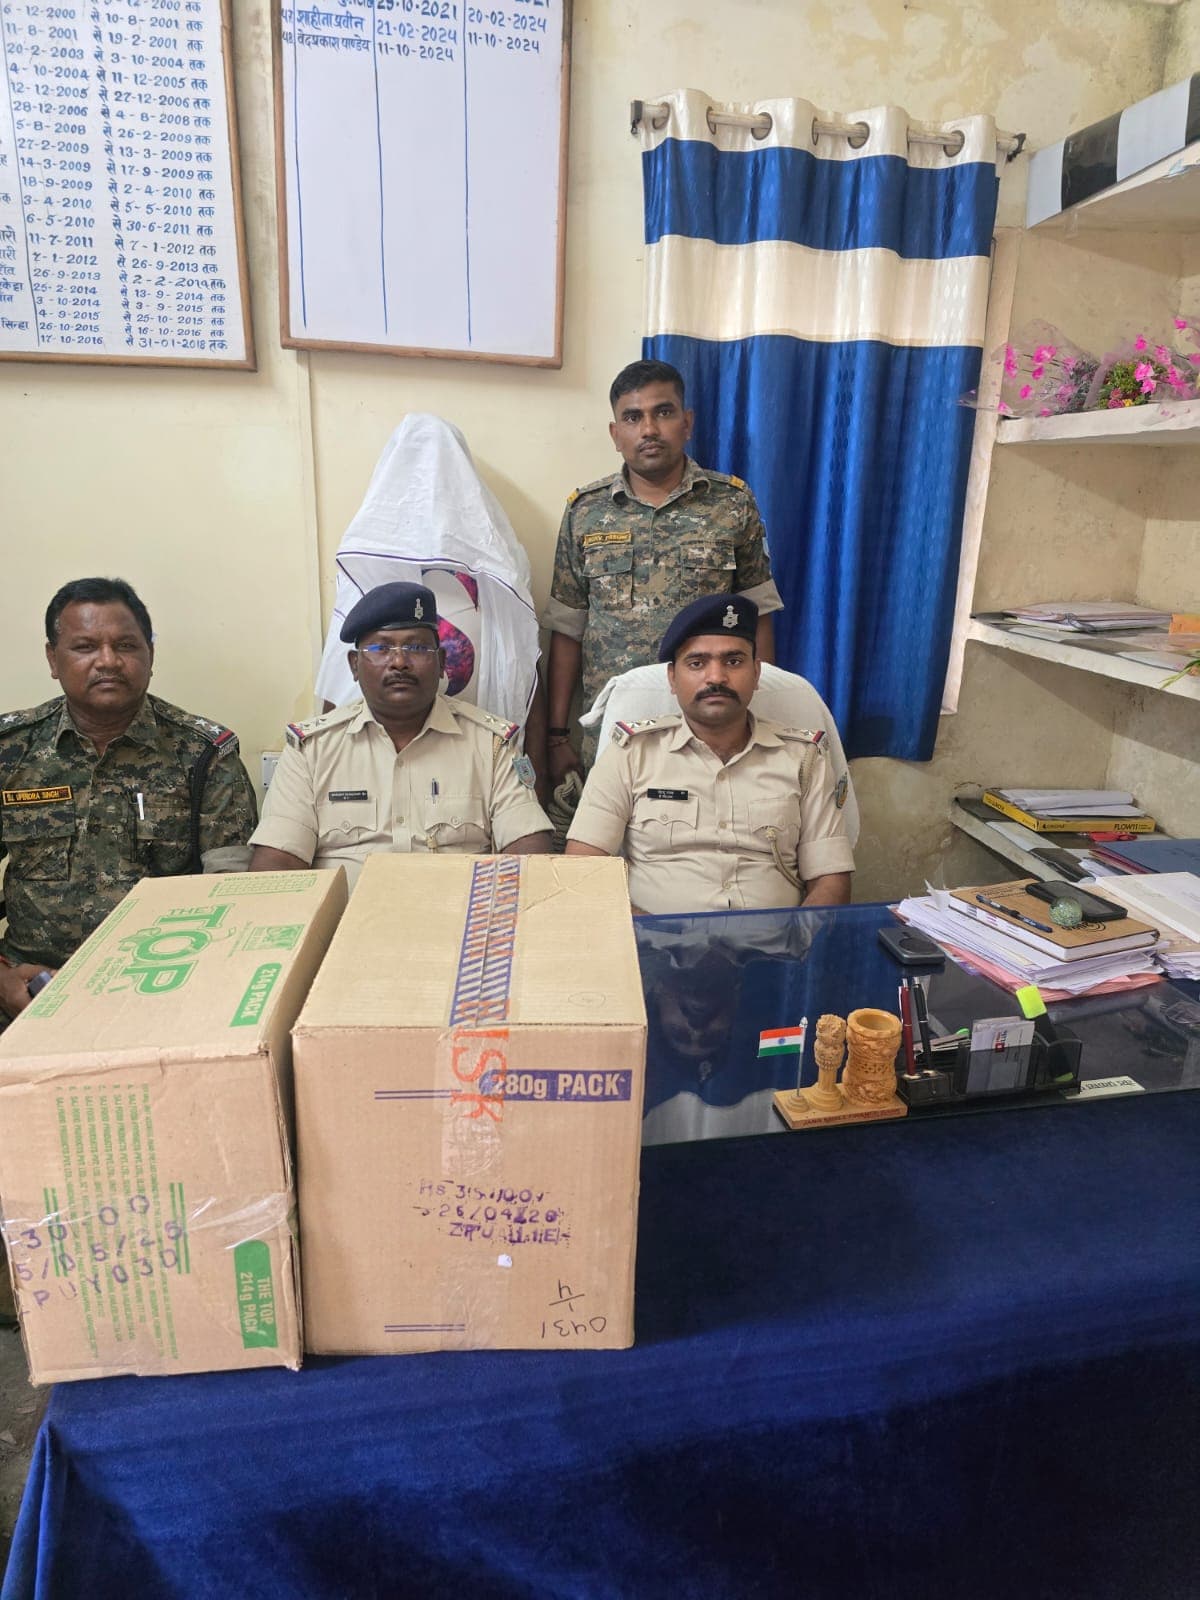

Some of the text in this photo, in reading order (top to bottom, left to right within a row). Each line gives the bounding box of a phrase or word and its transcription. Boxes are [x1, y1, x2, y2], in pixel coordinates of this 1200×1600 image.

[120, 903, 235, 996] TOP
[557, 1072, 622, 1097] PACK
[243, 1303, 258, 1334] PACK
[257, 1277, 274, 1325] THE TOP
